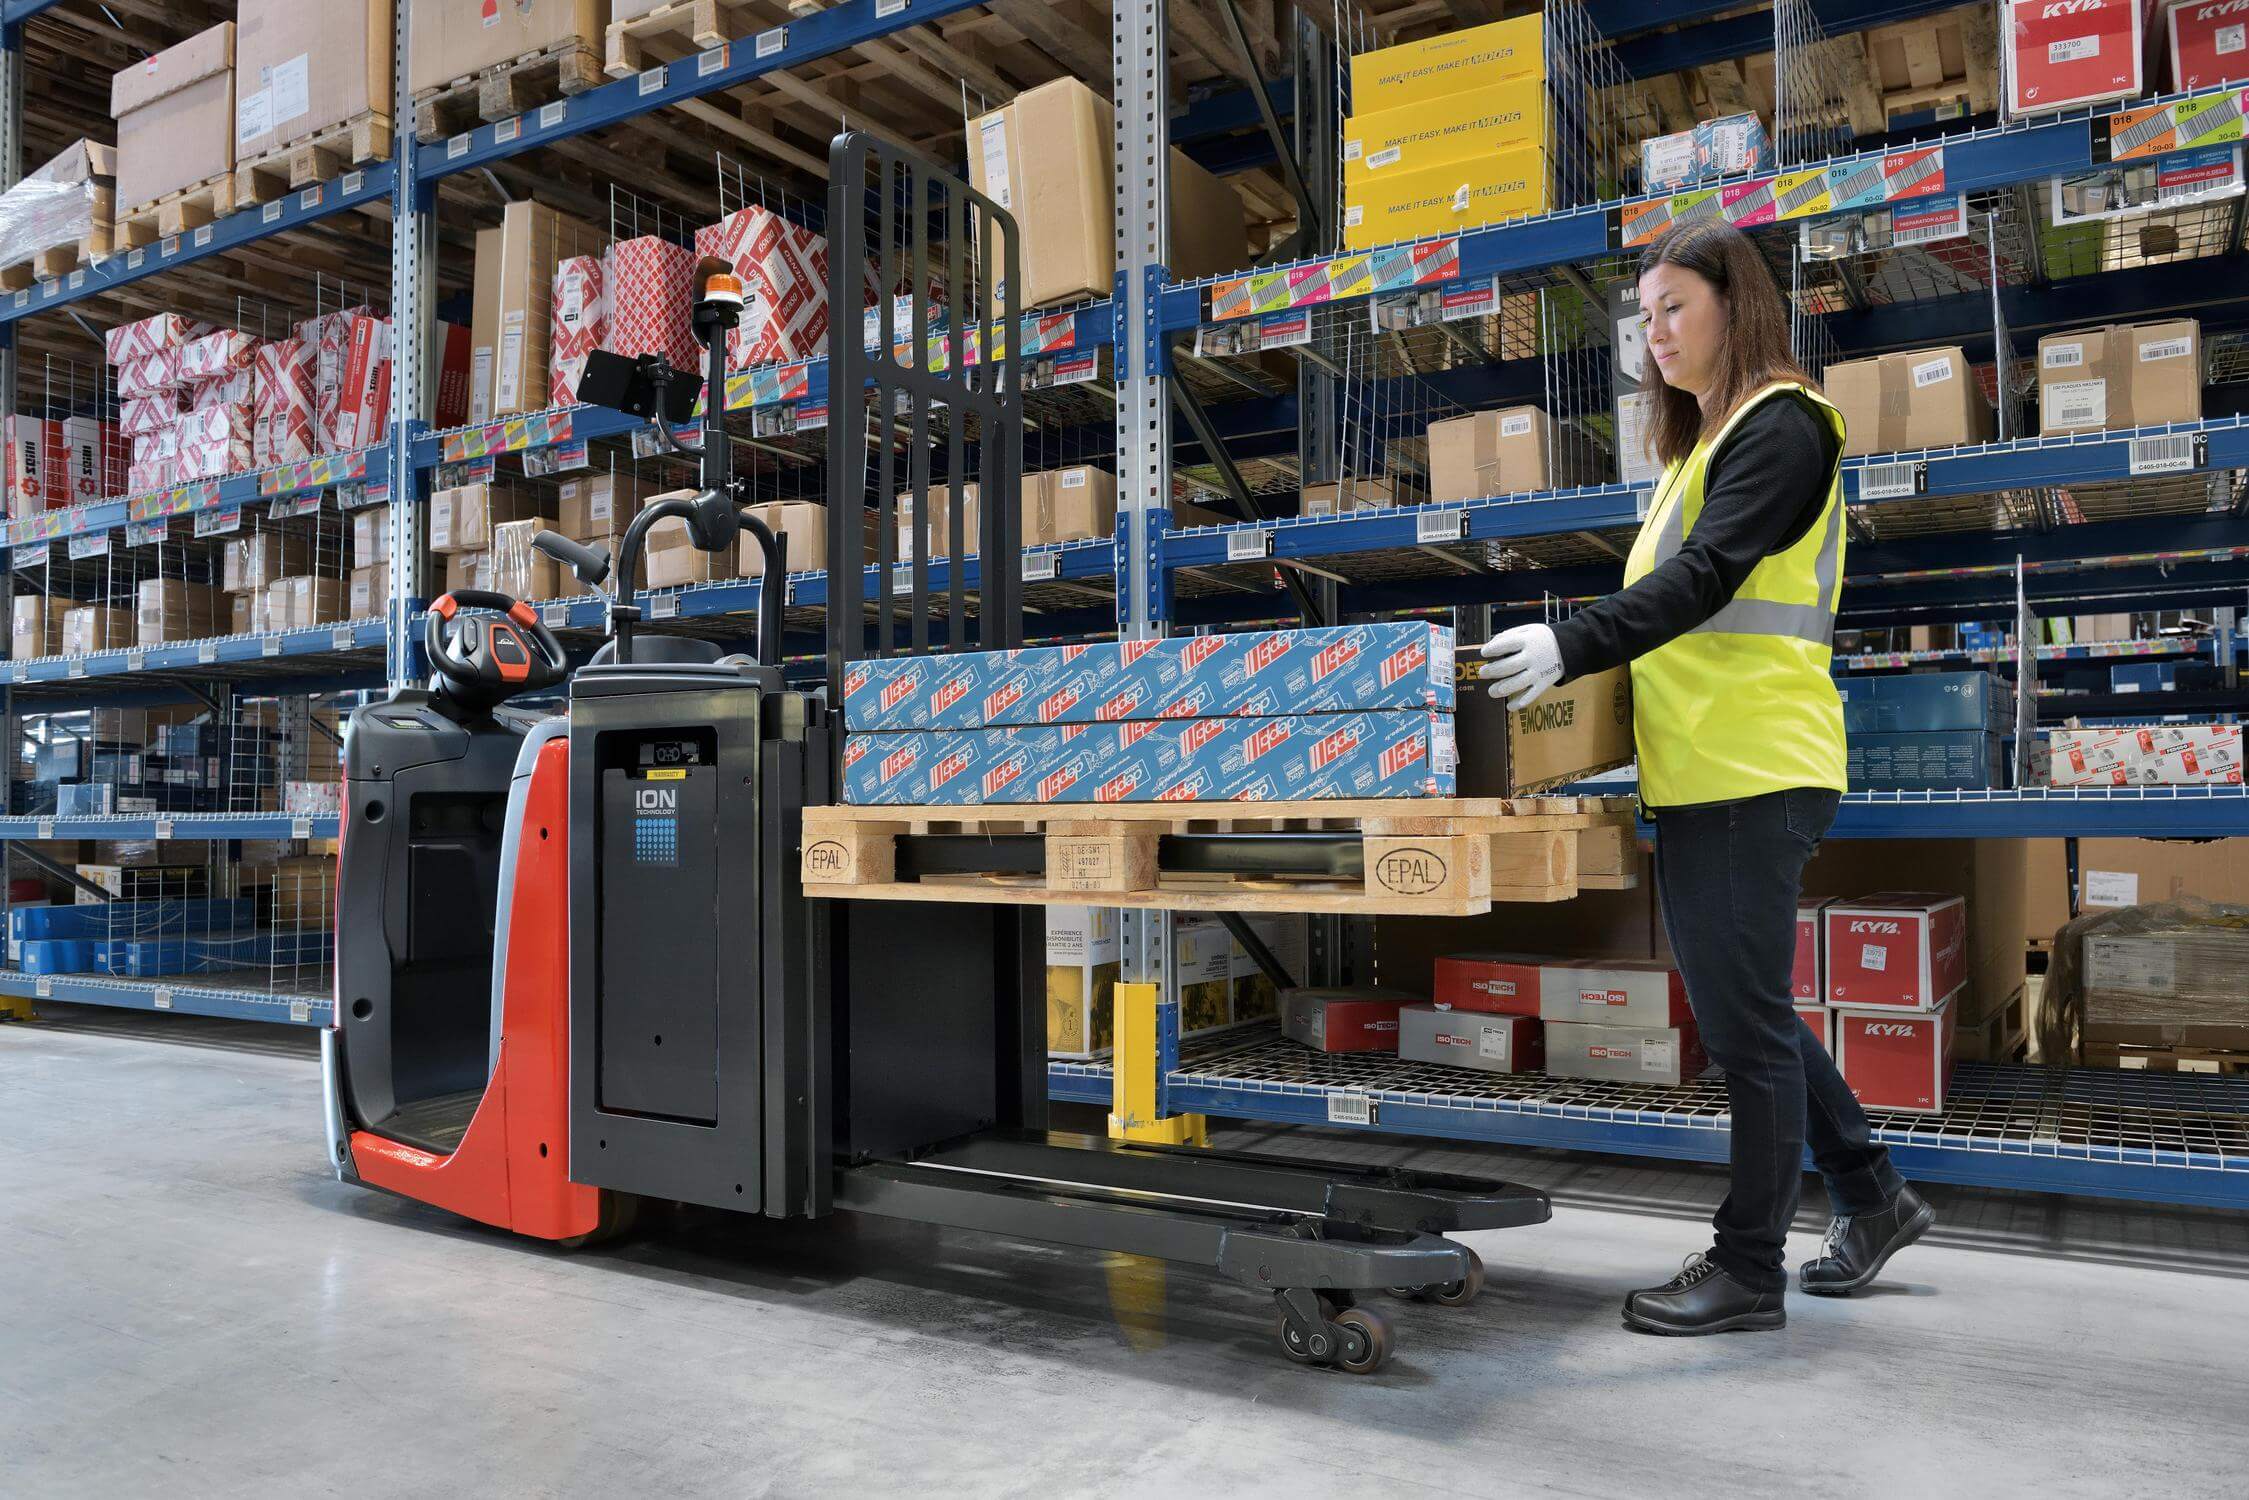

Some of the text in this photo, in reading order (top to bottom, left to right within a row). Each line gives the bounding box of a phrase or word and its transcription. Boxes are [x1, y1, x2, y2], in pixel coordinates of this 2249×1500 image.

[2053, 40, 2081, 50] 333700
[1379, 74, 1402, 86] MAKE
[1402, 71, 1412, 80] IT
[1437, 60, 1460, 72] MAKE
[1462, 57, 1471, 67] IT
[2178, 103, 2197, 113] 018
[2113, 115, 2132, 126] 018
[1385, 135, 1408, 147] MAKE
[1410, 131, 1418, 141] IT
[1443, 122, 1468, 135] MAKE
[1469, 121, 1478, 130] IT
[2218, 131, 2241, 141] 30-03
[2152, 142, 2174, 152] 20-03
[1887, 158, 1904, 168] 018
[1831, 168, 1848, 178] 018
[2165, 172, 2205, 183] PREPARATION
[1777, 178, 1793, 188] 018
[1725, 188, 1740, 198] 018
[1921, 184, 1941, 193] 70-02
[1388, 201, 1412, 214] MAKE
[1413, 199, 1422, 209] IT
[1473, 190, 1481, 198] IT
[1674, 197, 1689, 207] 018
[1624, 207, 1639, 217] 018
[1809, 204, 1828, 213] 50-02
[1899, 217, 1934, 228] PREPARATION
[726, 215, 745, 249] DENSO
[758, 229, 775, 252] DENSO
[1415, 247, 1429, 255] 018
[1373, 255, 1386, 263] 018
[784, 249, 804, 282] DENSO
[1441, 270, 1457, 278] 70-01
[782, 292, 798, 317] DENSO
[808, 315, 824, 340] DENSO
[2193, 435, 2208, 444] 0C
[1914, 463, 1927, 472] 0C
[1526, 700, 1569, 733] MONROE
[636, 790, 676, 808] ION
[812, 850, 842, 869] EPAL
[1387, 858, 1434, 884] EPAL
[1850, 921, 1899, 934] KYB
[1864, 1023, 1913, 1037] KYB
